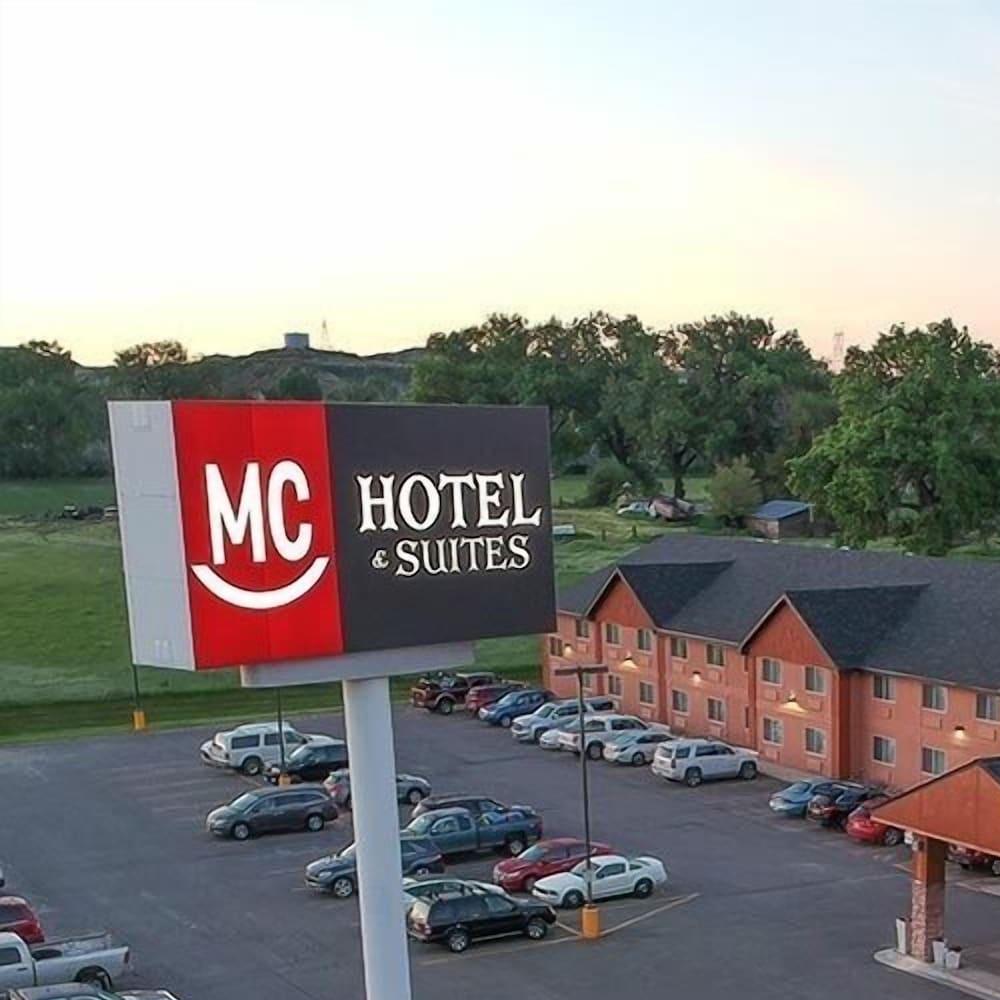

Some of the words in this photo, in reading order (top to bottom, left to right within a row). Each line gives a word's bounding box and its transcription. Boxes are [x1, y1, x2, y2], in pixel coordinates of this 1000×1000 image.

[204, 460, 313, 565] MC
[356, 472, 543, 533] HOTEL
[371, 549, 389, 569] &
[395, 535, 530, 577] SUITES
